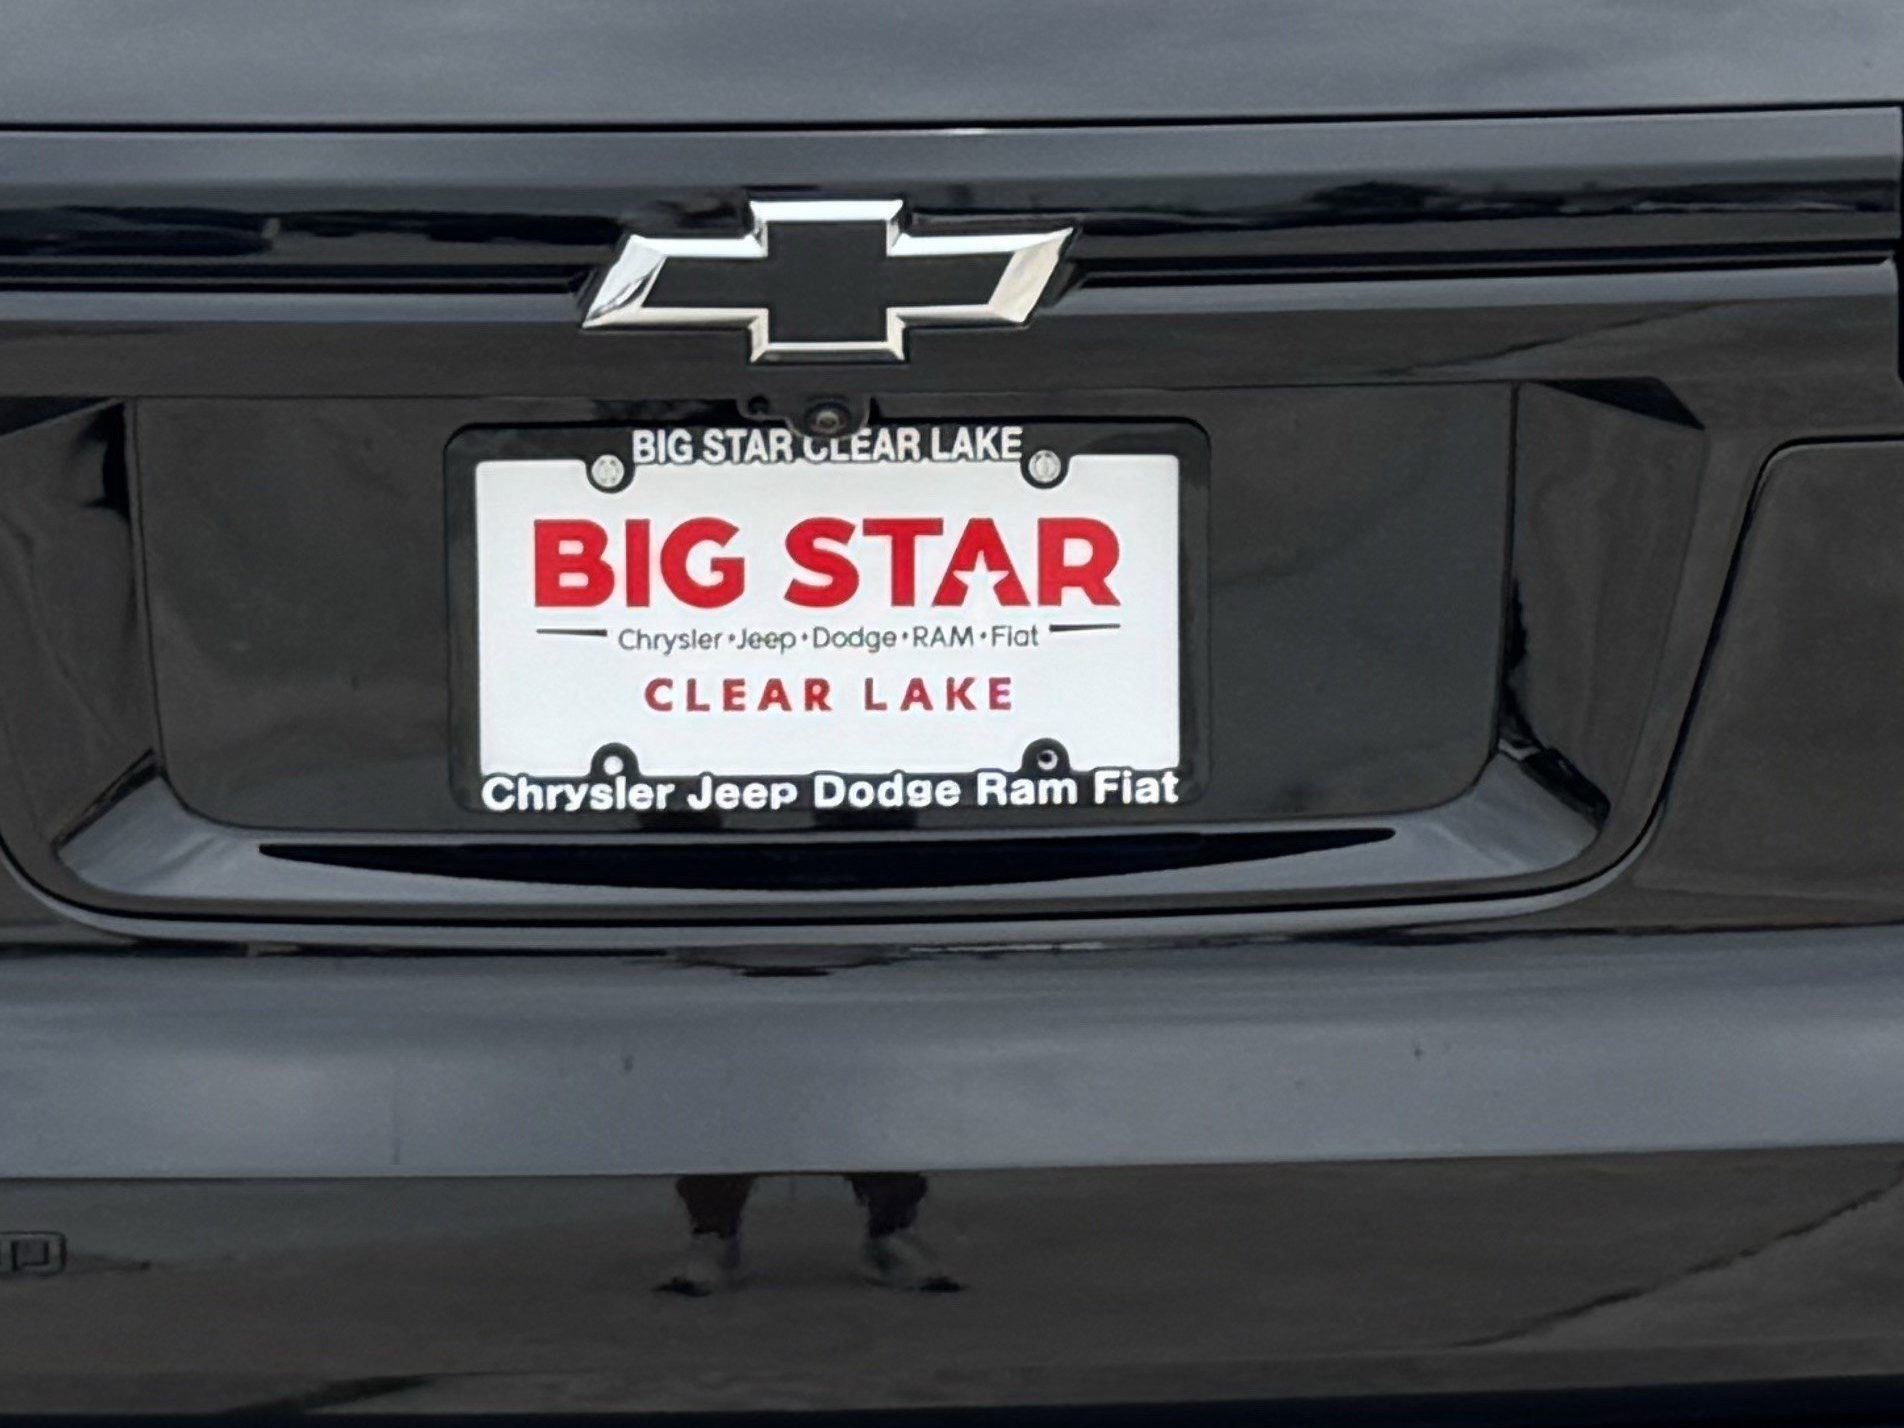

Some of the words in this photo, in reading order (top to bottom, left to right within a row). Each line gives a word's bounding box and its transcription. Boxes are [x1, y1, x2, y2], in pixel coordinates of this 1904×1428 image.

[631, 429, 693, 464] BIG
[702, 428, 794, 463] STAR
[803, 427, 922, 462] CLEAR
[930, 426, 1023, 461] LAKE
[533, 517, 746, 609] BIG
[784, 516, 1121, 608] STAR
[617, 628, 723, 656] Chrysler
[736, 629, 797, 655] Jeep
[812, 626, 897, 653] Dodge
[912, 627, 975, 648] RAM
[990, 624, 1039, 648] Fiat
[644, 677, 833, 713] CLEAR
[864, 676, 1013, 711] LAKE
[481, 774, 676, 813] Chrysler
[687, 774, 799, 812] Jeep
[813, 772, 962, 809] Dodge
[976, 770, 1078, 807] Ram
[1093, 769, 1180, 805] Fiat
